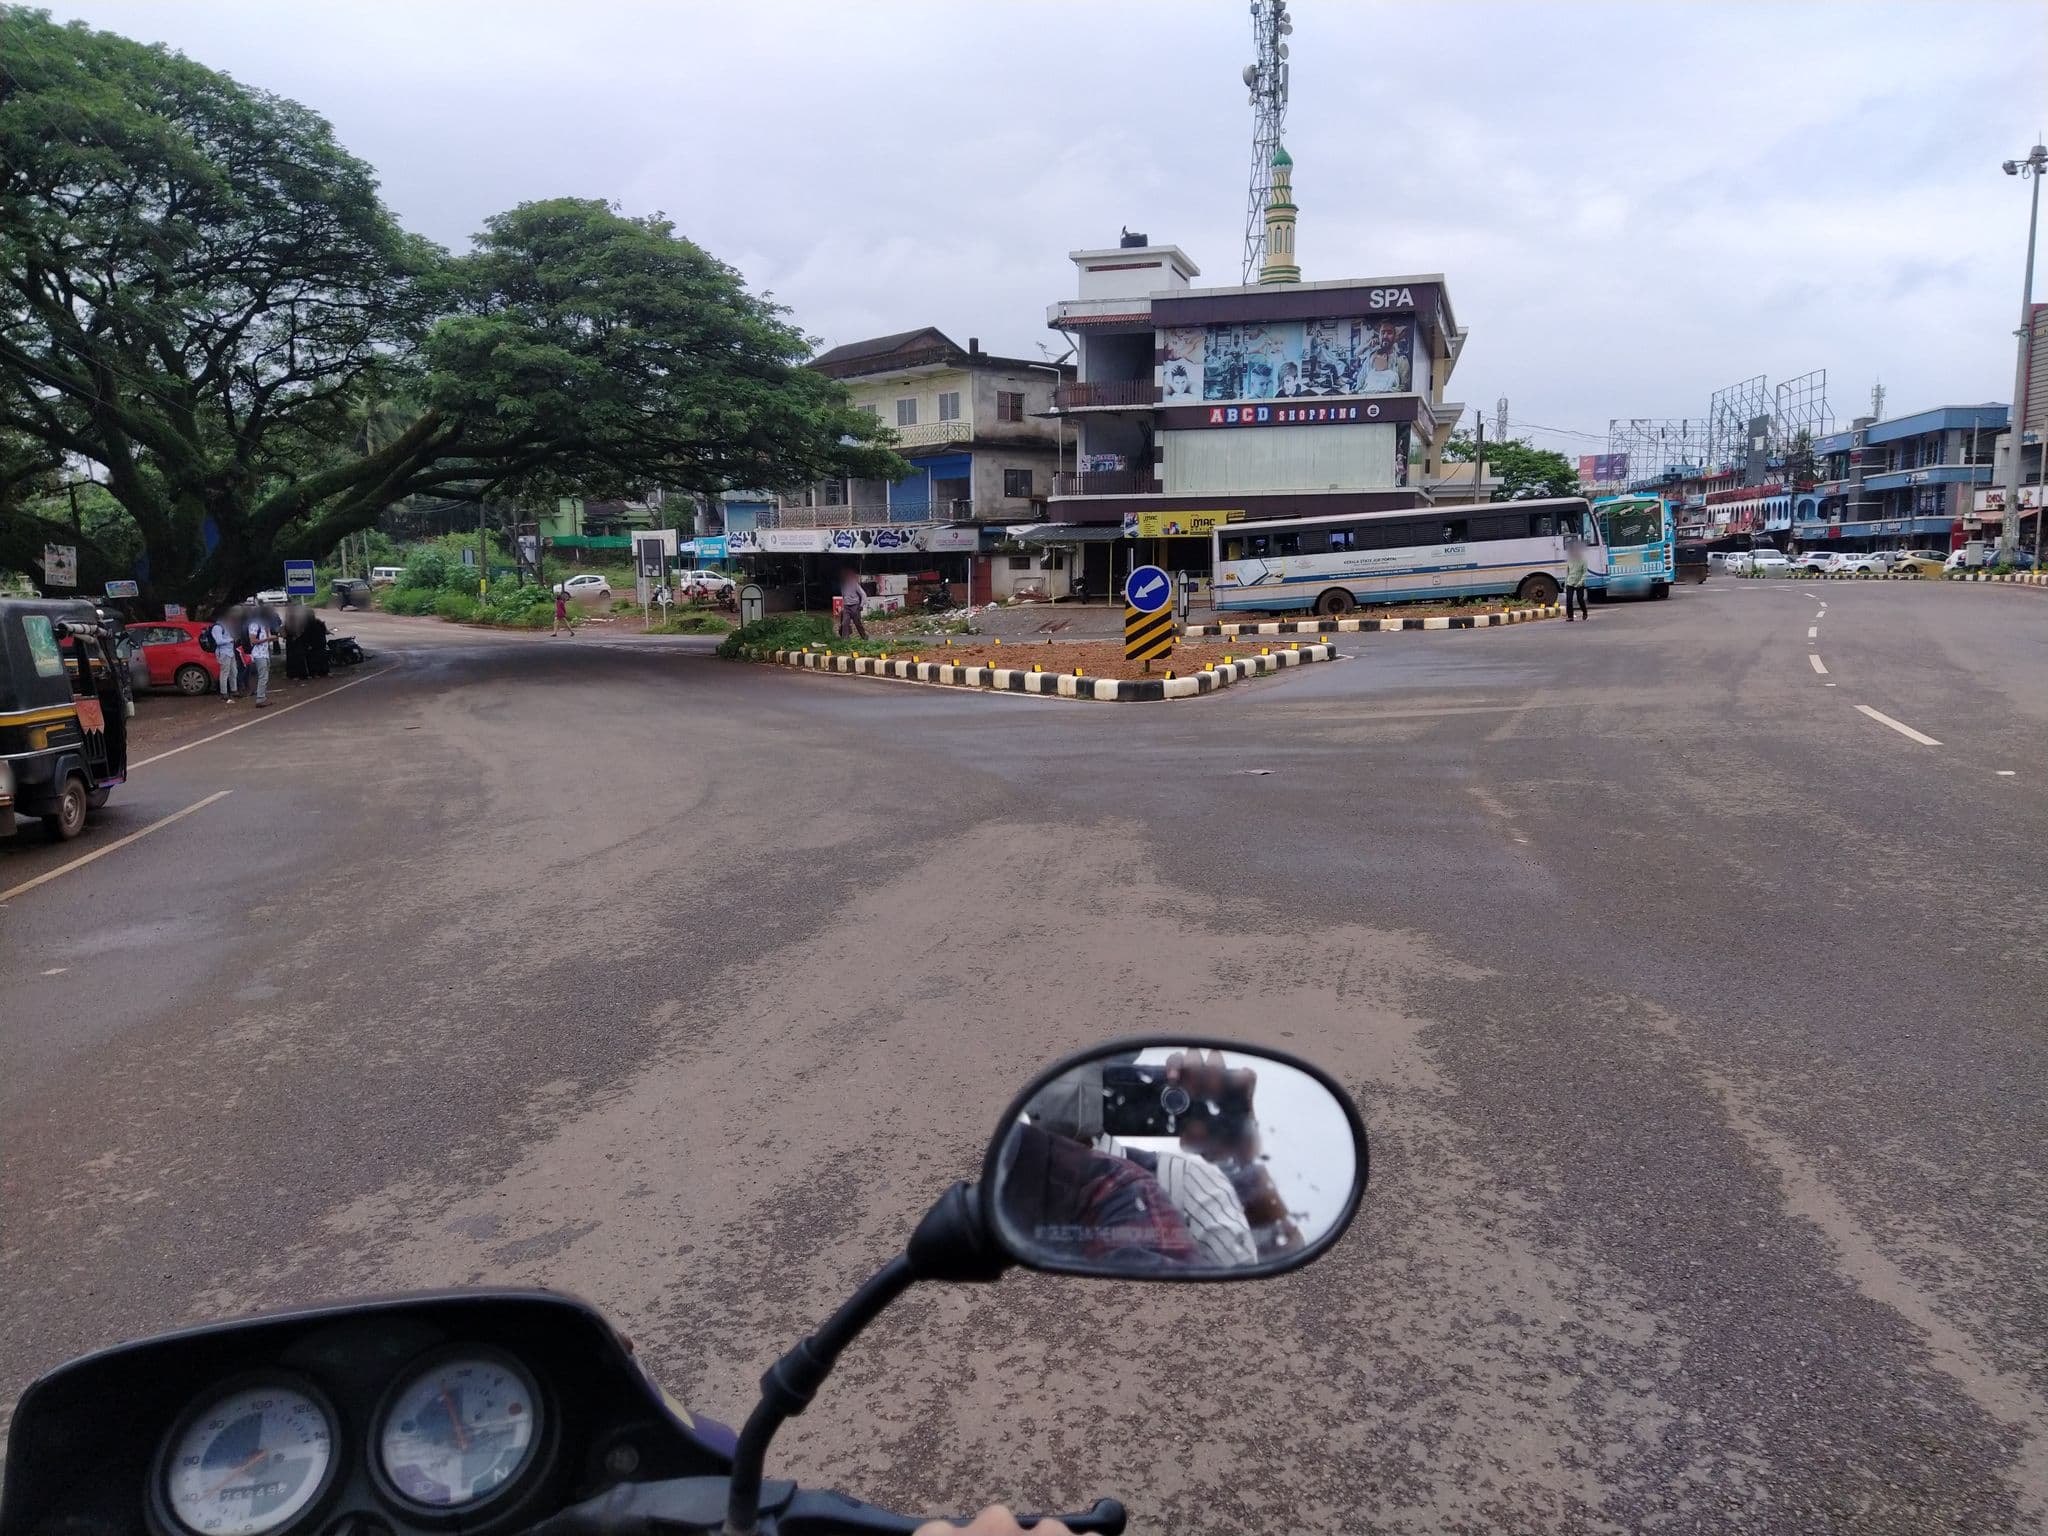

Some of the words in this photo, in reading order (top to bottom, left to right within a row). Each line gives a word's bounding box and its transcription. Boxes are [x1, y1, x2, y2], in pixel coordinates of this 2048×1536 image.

[1370, 288, 1414, 308] SPA
[1210, 407, 1270, 423] ABCD
[1278, 408, 1356, 421] SHOPPING
